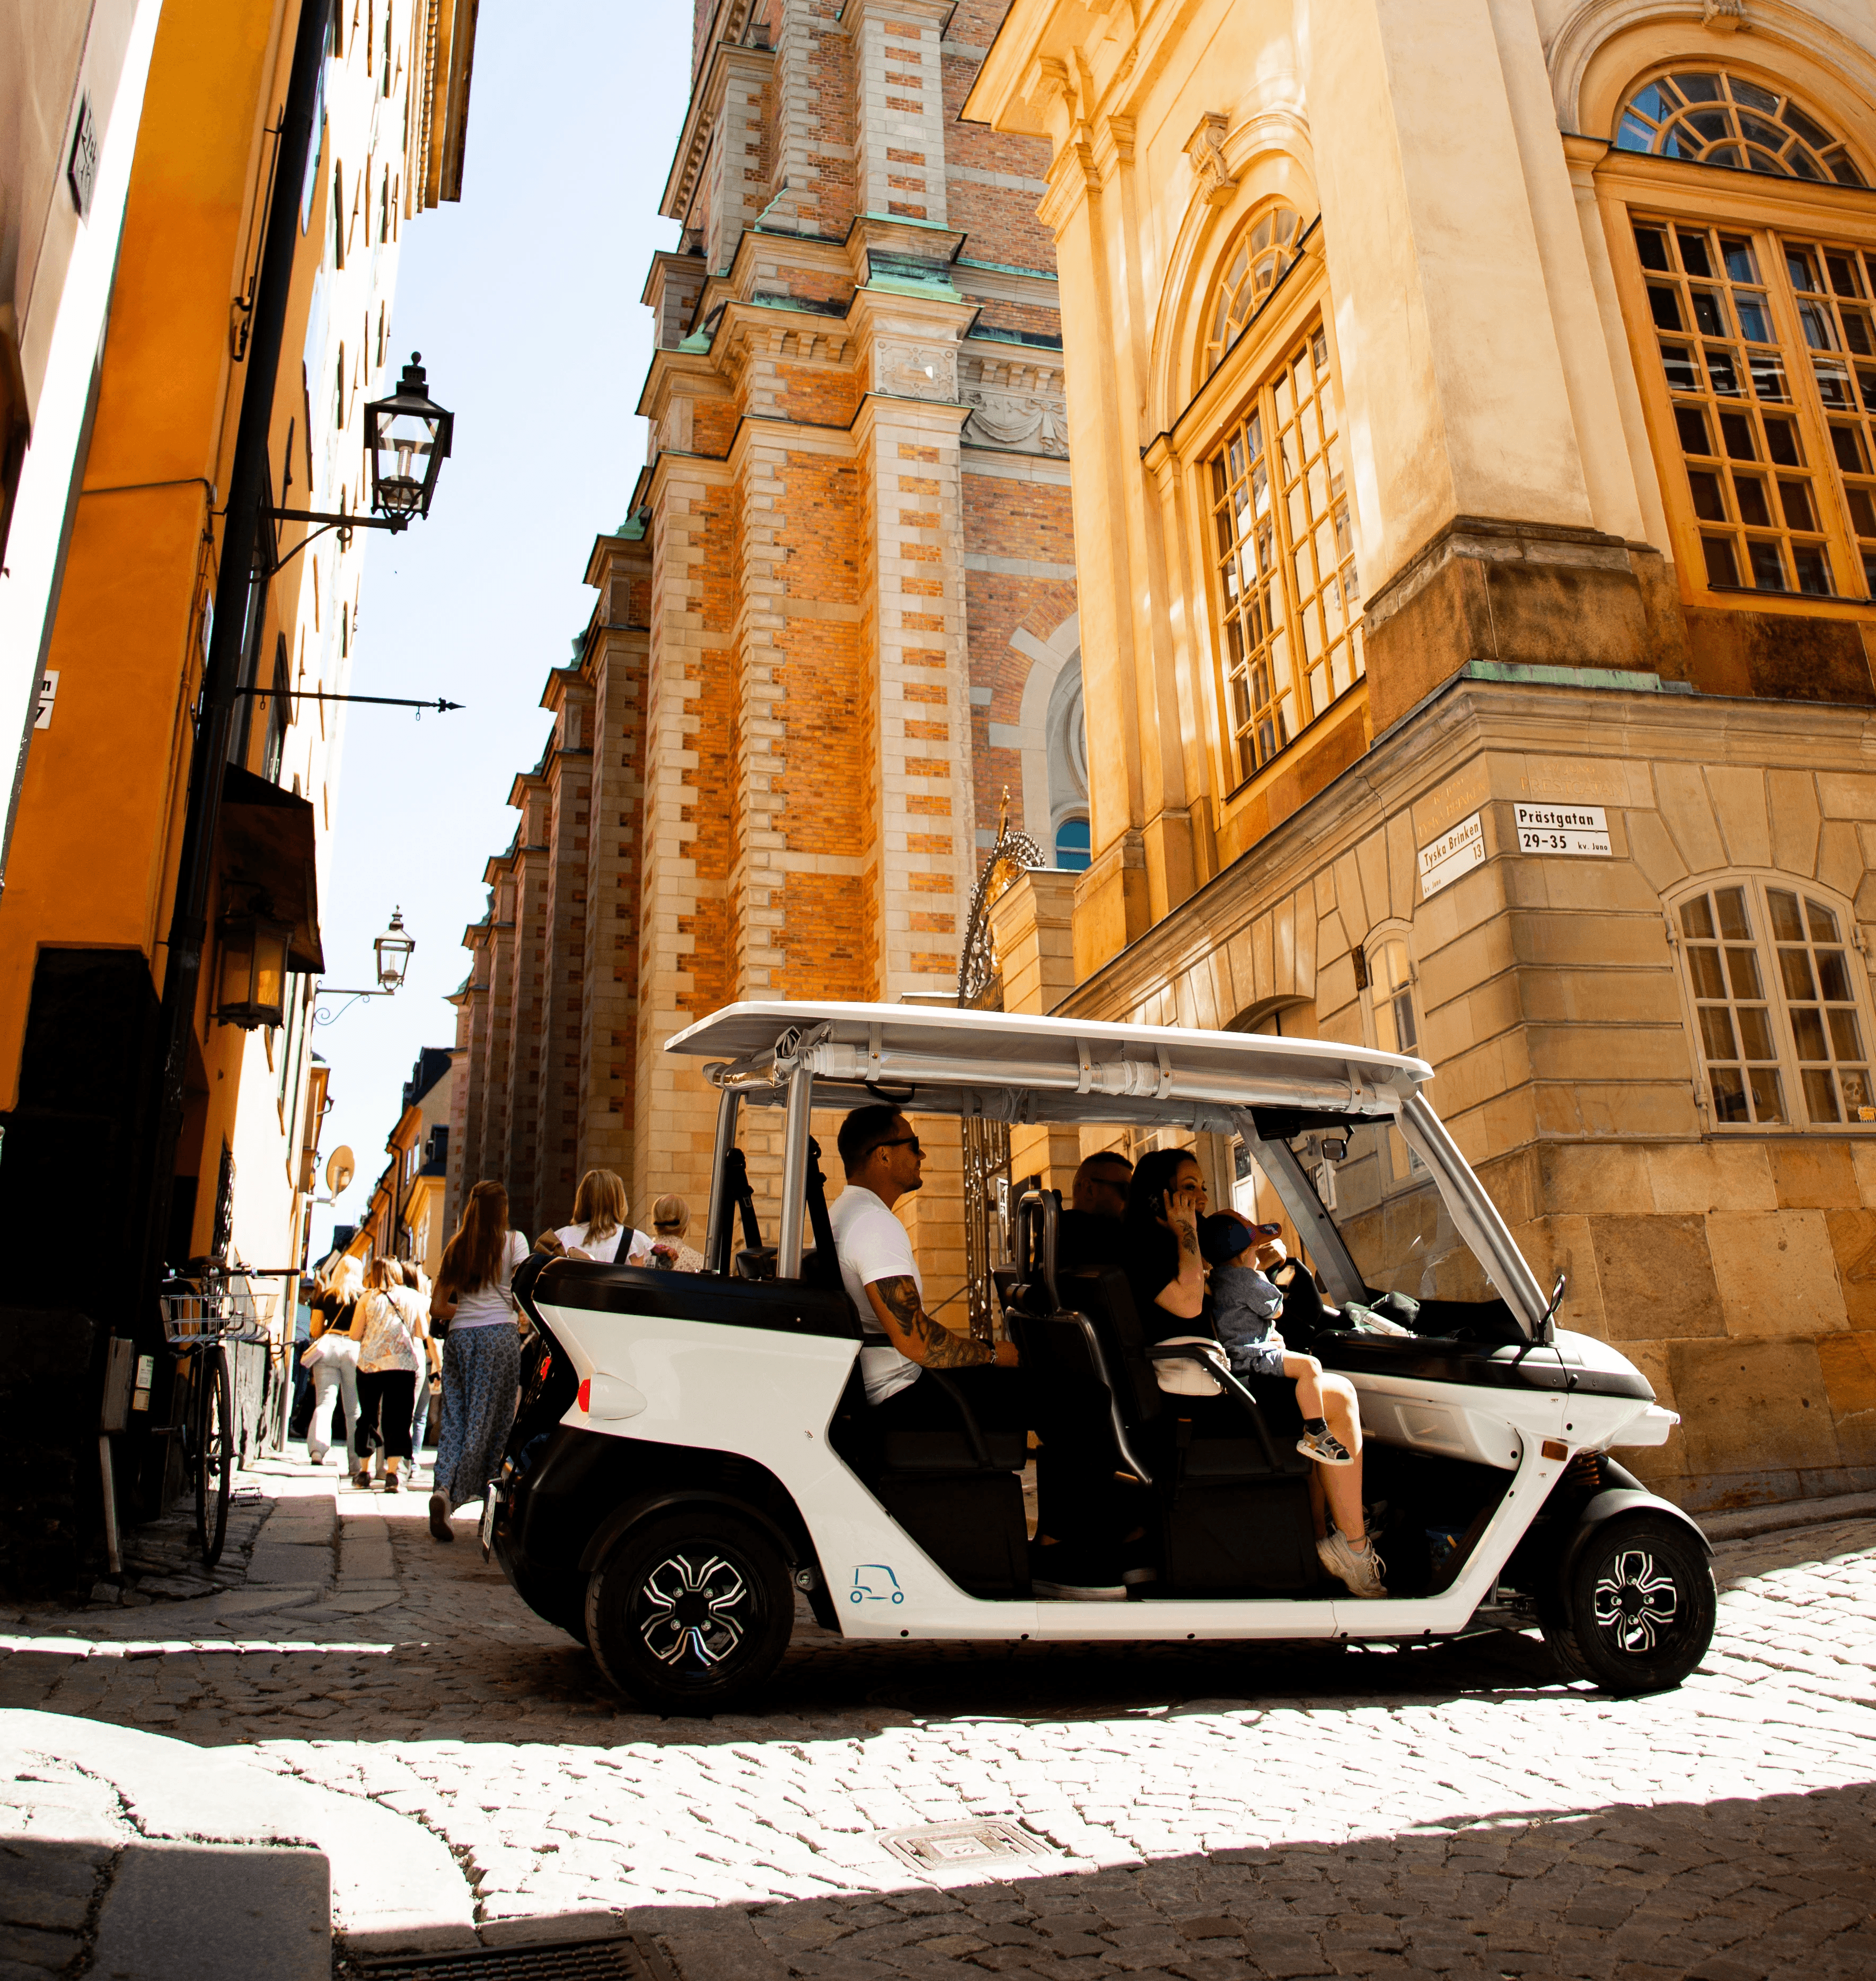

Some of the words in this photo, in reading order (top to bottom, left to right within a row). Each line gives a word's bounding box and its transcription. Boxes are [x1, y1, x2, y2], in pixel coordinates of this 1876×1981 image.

[1520, 777, 1624, 797] PRESTGATAN
[1519, 809, 1594, 827] Prästgatan
[1424, 844, 1446, 868] Tyska
[1448, 823, 1479, 850] Brinken
[1523, 833, 1566, 849] 29-35
[1473, 843, 1482, 860] 13
[1432, 879, 1441, 889] Juno
